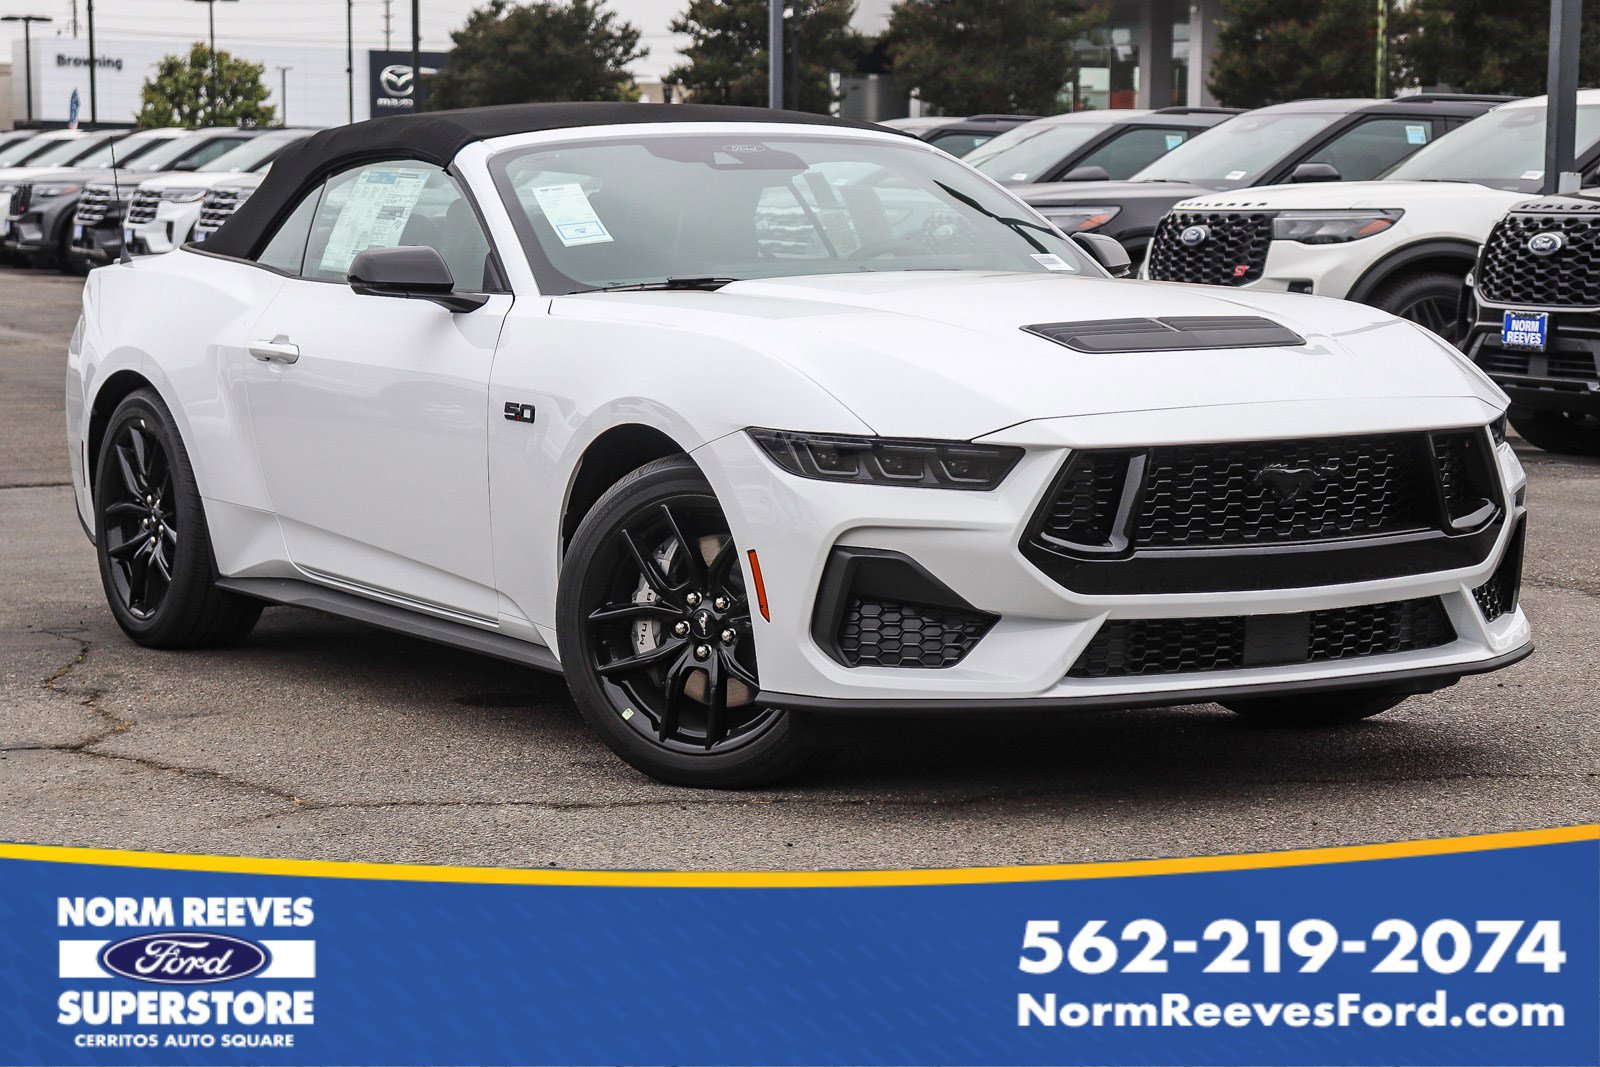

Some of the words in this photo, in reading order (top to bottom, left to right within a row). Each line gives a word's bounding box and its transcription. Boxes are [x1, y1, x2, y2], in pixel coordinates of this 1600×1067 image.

[57, 53, 122, 71] Browning
[1511, 319, 1540, 332] NORM
[1506, 330, 1542, 345] REEVES
